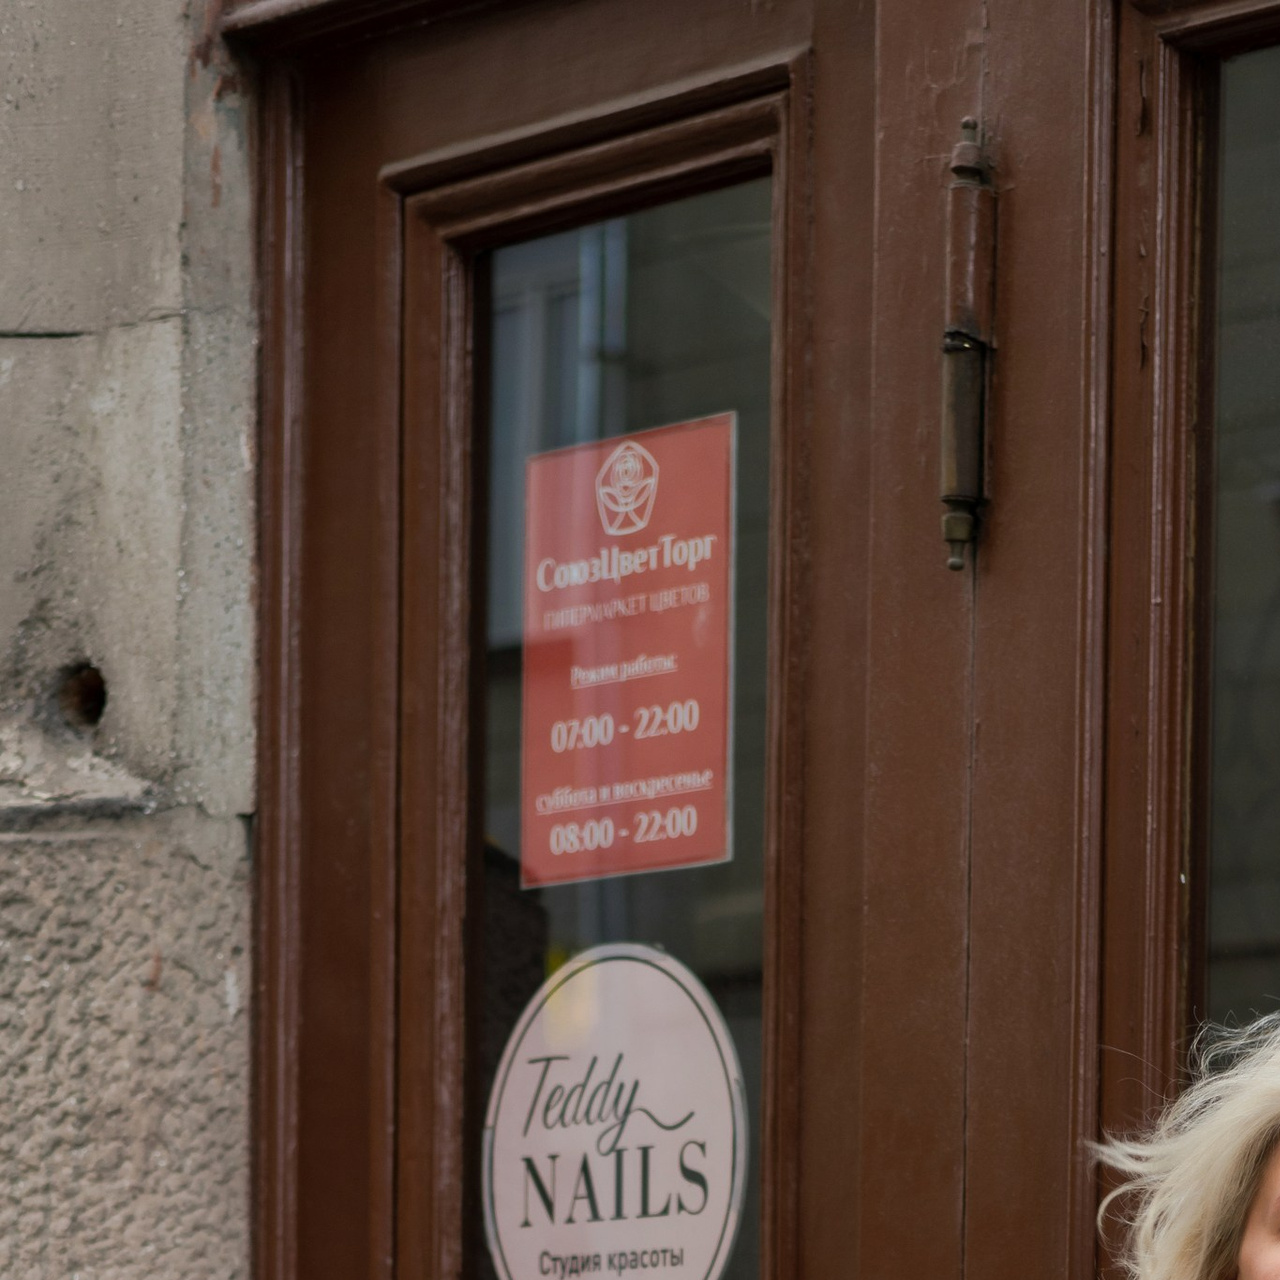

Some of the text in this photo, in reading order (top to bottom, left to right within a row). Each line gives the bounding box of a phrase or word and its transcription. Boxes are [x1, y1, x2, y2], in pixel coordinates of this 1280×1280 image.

[536, 533, 718, 592] СоюзЦветТорг
[551, 712, 615, 753] 07:00
[634, 699, 700, 740] 22:00
[600, 786, 612, 802] и
[550, 816, 615, 856] 08:00
[634, 804, 698, 844] 22:00
[522, 1052, 696, 1157] Teddy
[519, 1140, 710, 1228] NAILS
[539, 1245, 684, 1280] Студия красоты
